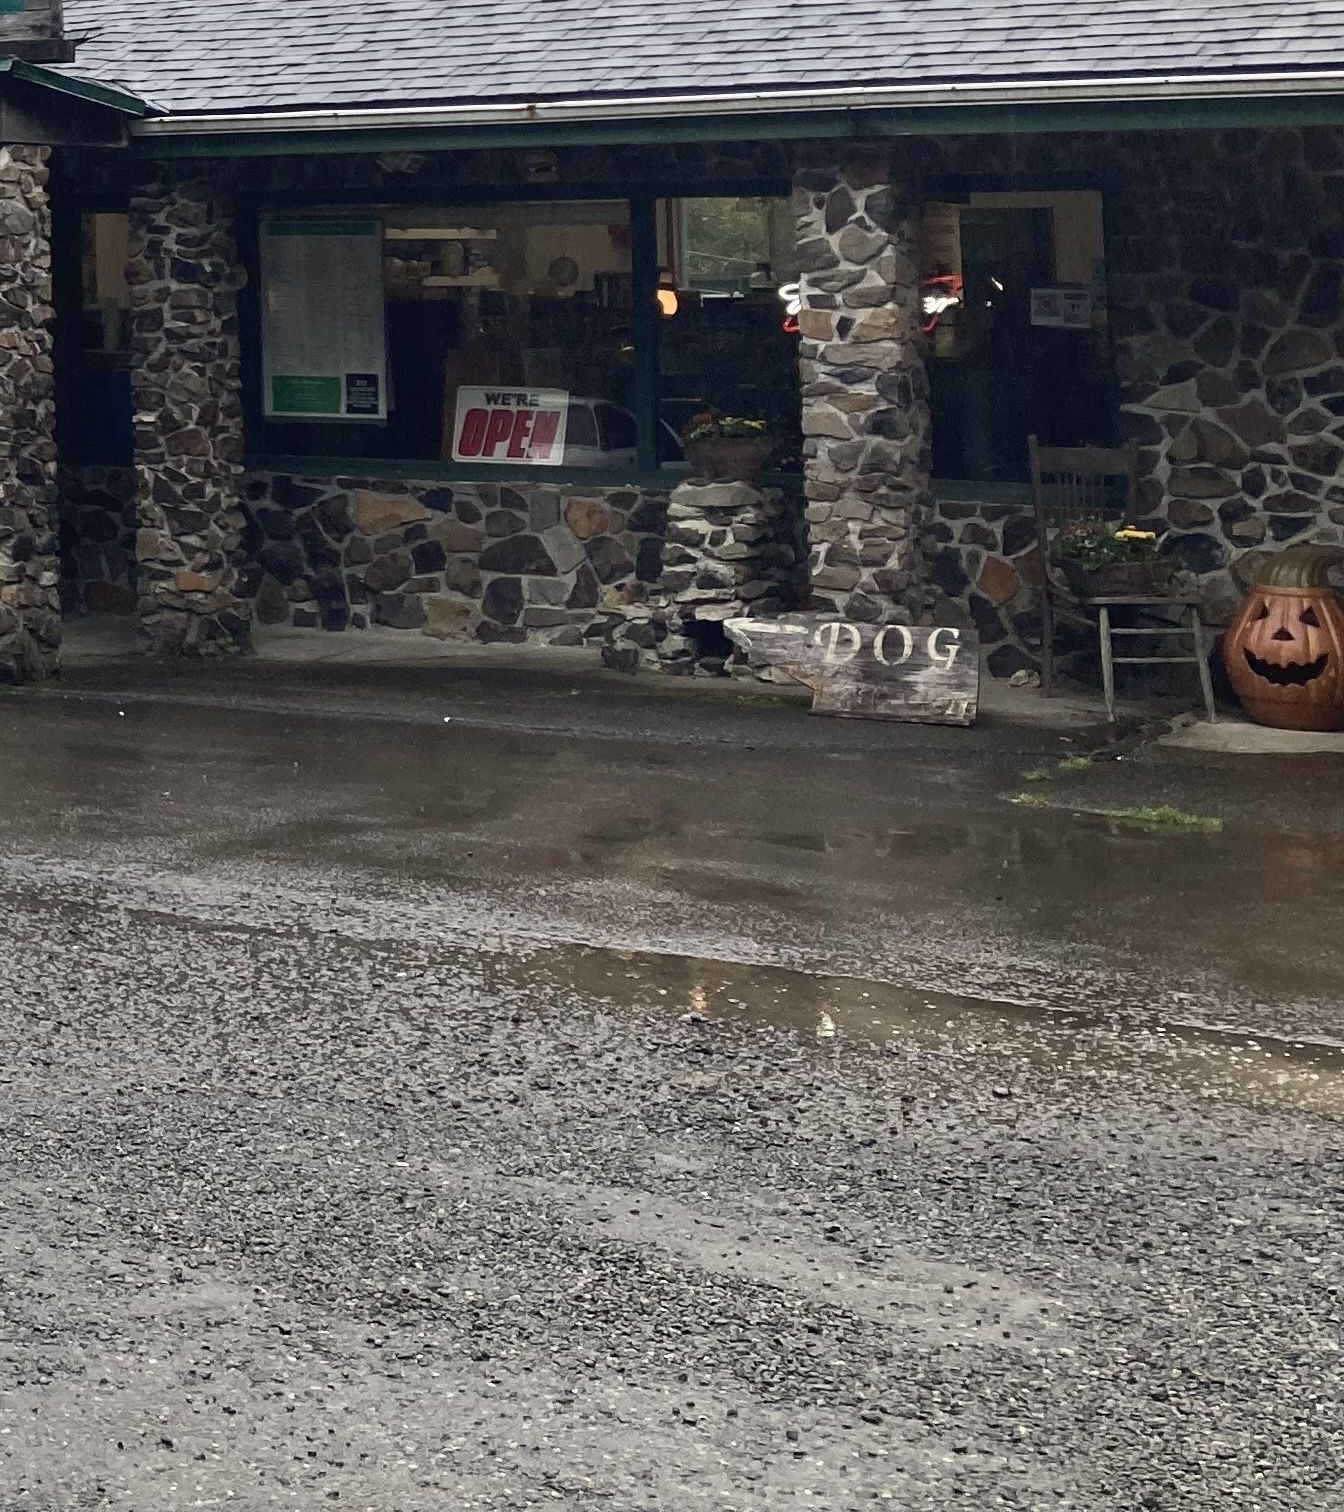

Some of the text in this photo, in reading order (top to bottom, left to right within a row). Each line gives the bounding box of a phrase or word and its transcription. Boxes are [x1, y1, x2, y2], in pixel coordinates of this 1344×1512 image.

[485, 392, 540, 407] WE'RE
[458, 408, 561, 460] OPEN
[814, 622, 961, 669] DOG
